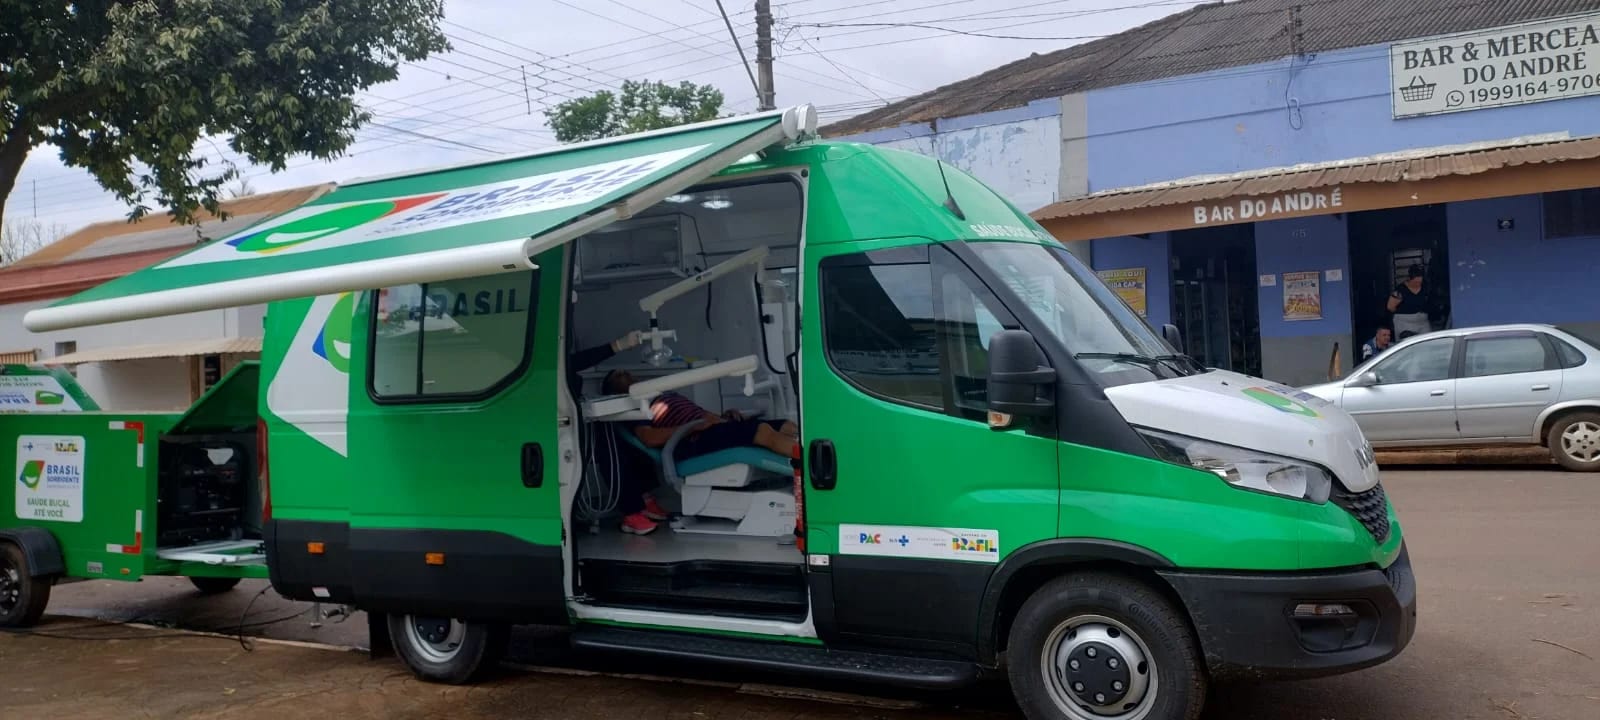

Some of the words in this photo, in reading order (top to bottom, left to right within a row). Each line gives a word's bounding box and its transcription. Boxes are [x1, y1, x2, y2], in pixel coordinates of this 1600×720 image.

[1403, 45, 1454, 70] BAR
[1461, 42, 1479, 62] &
[1463, 65, 1496, 85] DO
[1503, 48, 1587, 80] ANDRÉ
[429, 160, 657, 211] BRASIL
[1194, 206, 1235, 224] BAR
[1240, 200, 1266, 218] DO
[1271, 187, 1343, 214] ANDRÉ
[46, 464, 80, 475] BRASIL
[49, 498, 70, 507] BUCAL
[34, 508, 45, 517] ATÉ
[46, 508, 64, 518] VOCÊ
[859, 532, 881, 544] PAC
[952, 537, 997, 553] BRASIL
